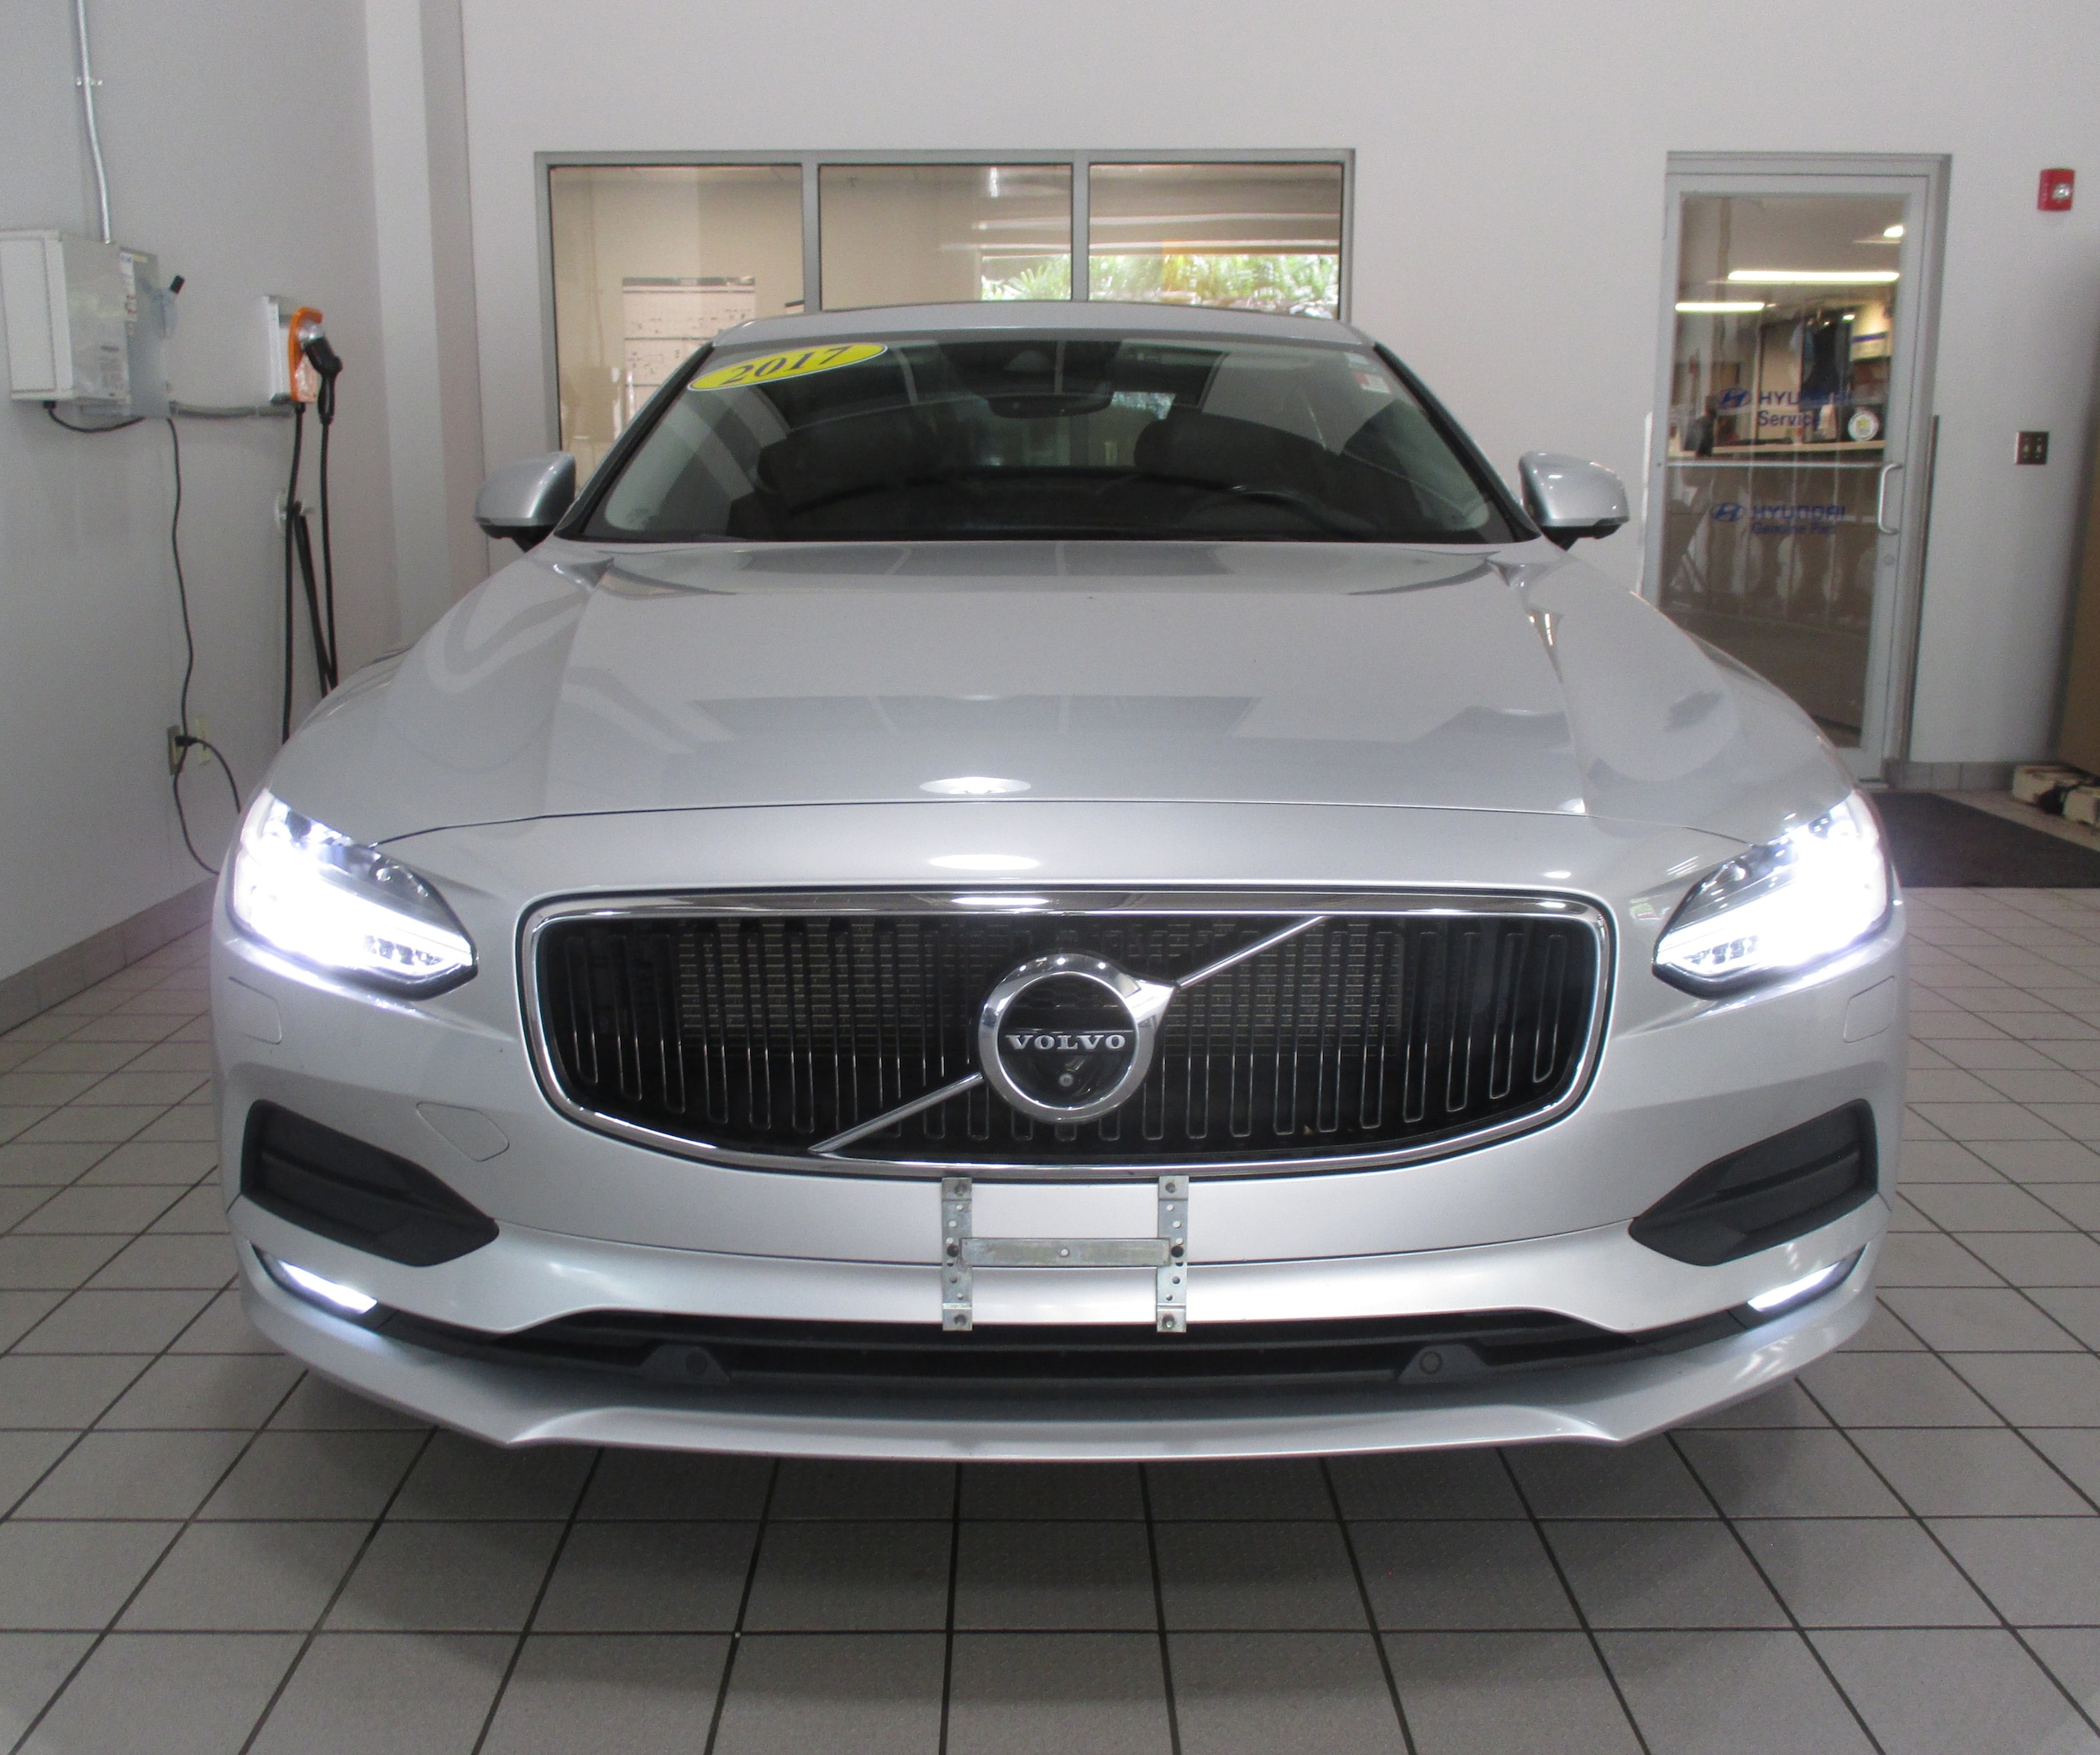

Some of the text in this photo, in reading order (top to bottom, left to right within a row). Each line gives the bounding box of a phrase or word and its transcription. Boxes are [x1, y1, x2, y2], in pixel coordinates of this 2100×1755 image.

[720, 344, 853, 386] 2017
[1758, 391, 1853, 406] HYUDI
[1005, 1034, 1126, 1050] VOLVO
